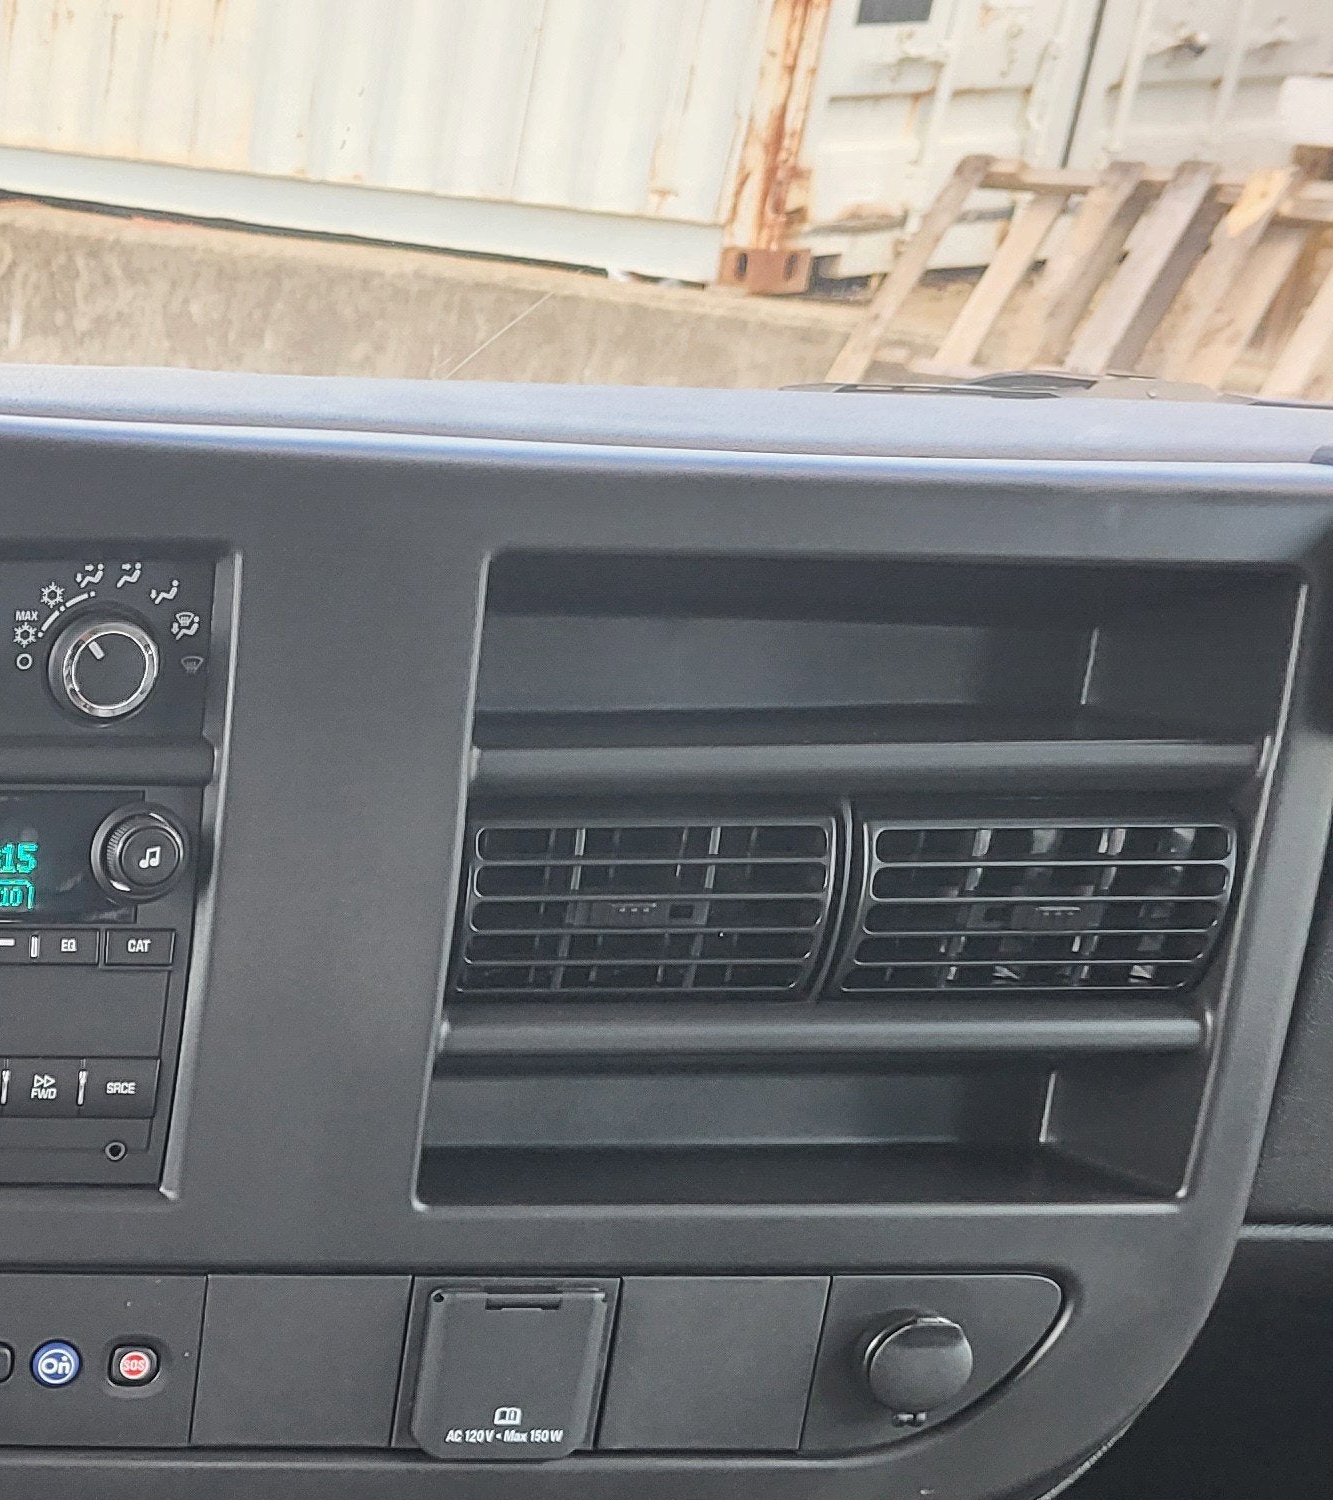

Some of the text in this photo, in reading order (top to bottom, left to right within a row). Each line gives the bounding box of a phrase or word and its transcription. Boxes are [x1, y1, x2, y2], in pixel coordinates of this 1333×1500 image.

[15, 610, 39, 621] MAX
[61, 938, 77, 952] EQ
[127, 939, 152, 952] CAT
[30, 1088, 57, 1100] FWD
[106, 1082, 136, 1095] SRCE
[122, 1359, 146, 1372] SOS
[445, 1429, 463, 1442] AC
[503, 1429, 528, 1443] Max
